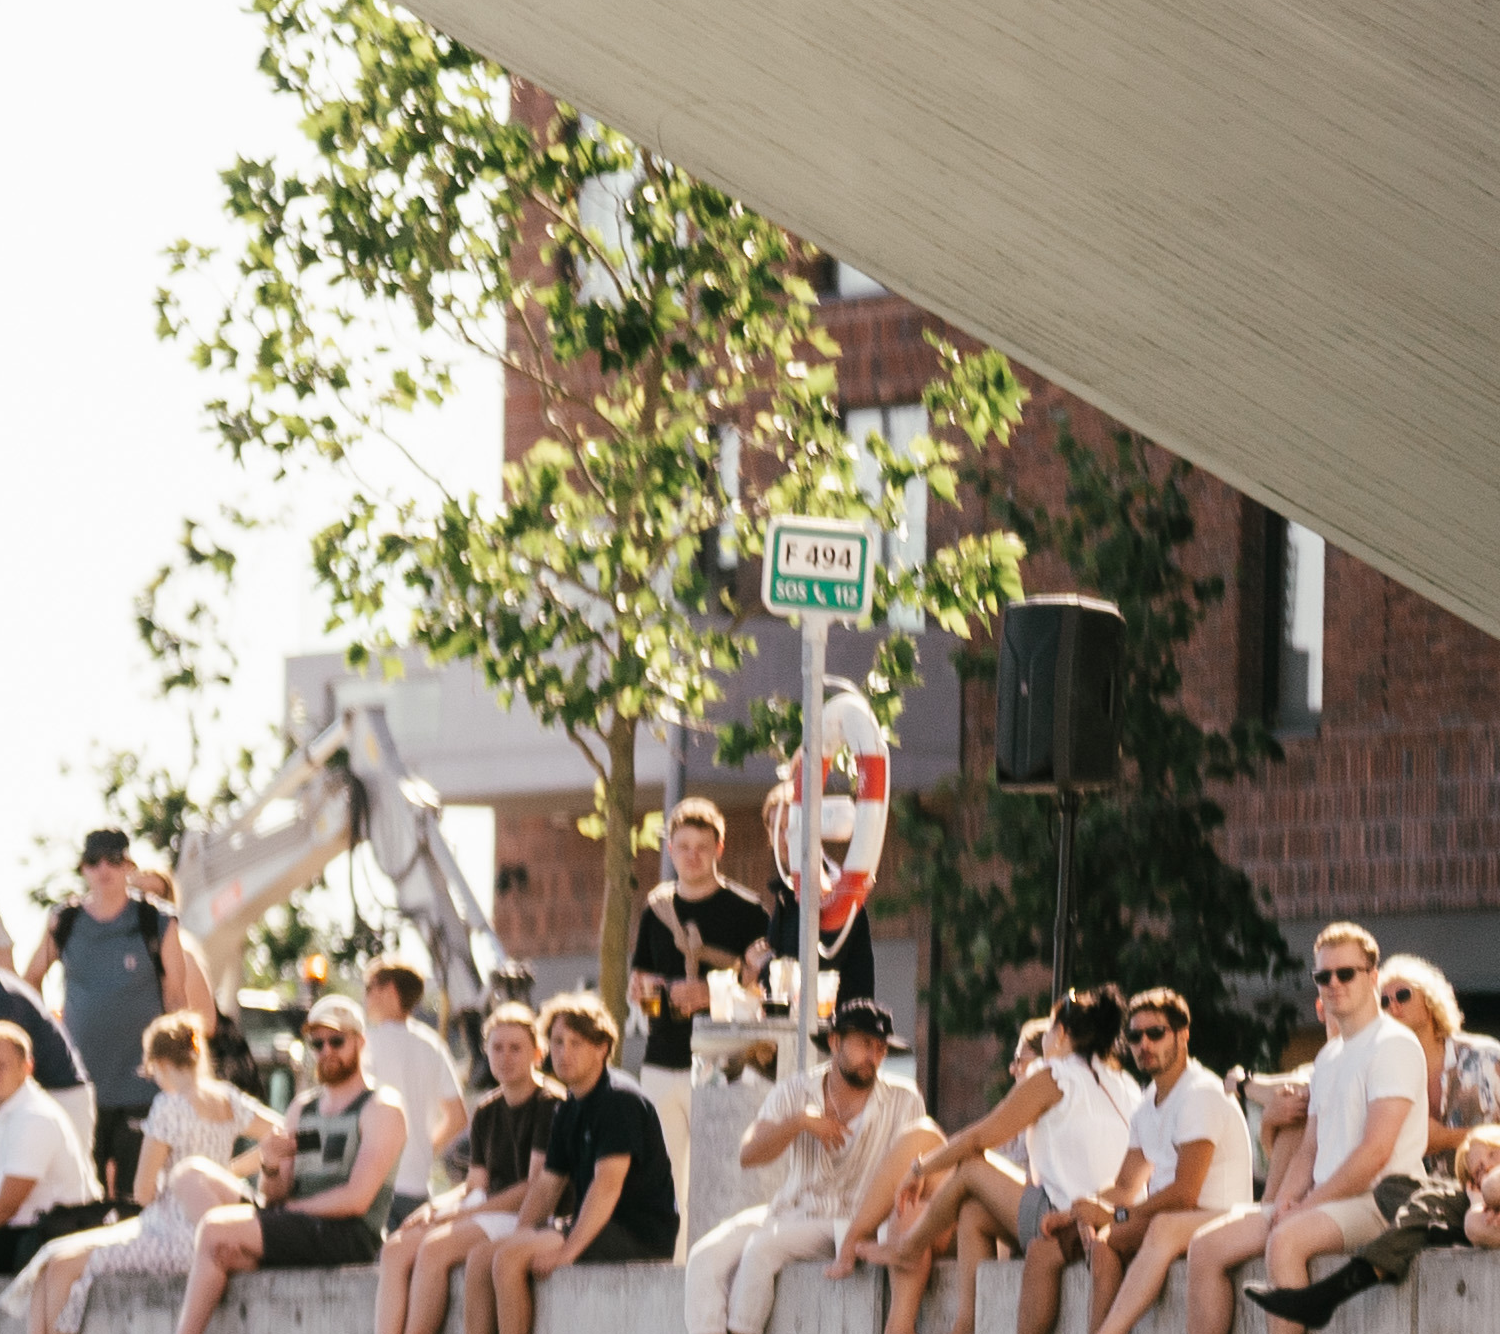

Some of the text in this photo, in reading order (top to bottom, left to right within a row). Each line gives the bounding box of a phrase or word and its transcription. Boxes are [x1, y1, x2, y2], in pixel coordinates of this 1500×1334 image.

[786, 541, 852, 572] F 494
[775, 578, 859, 608] SOS 112
